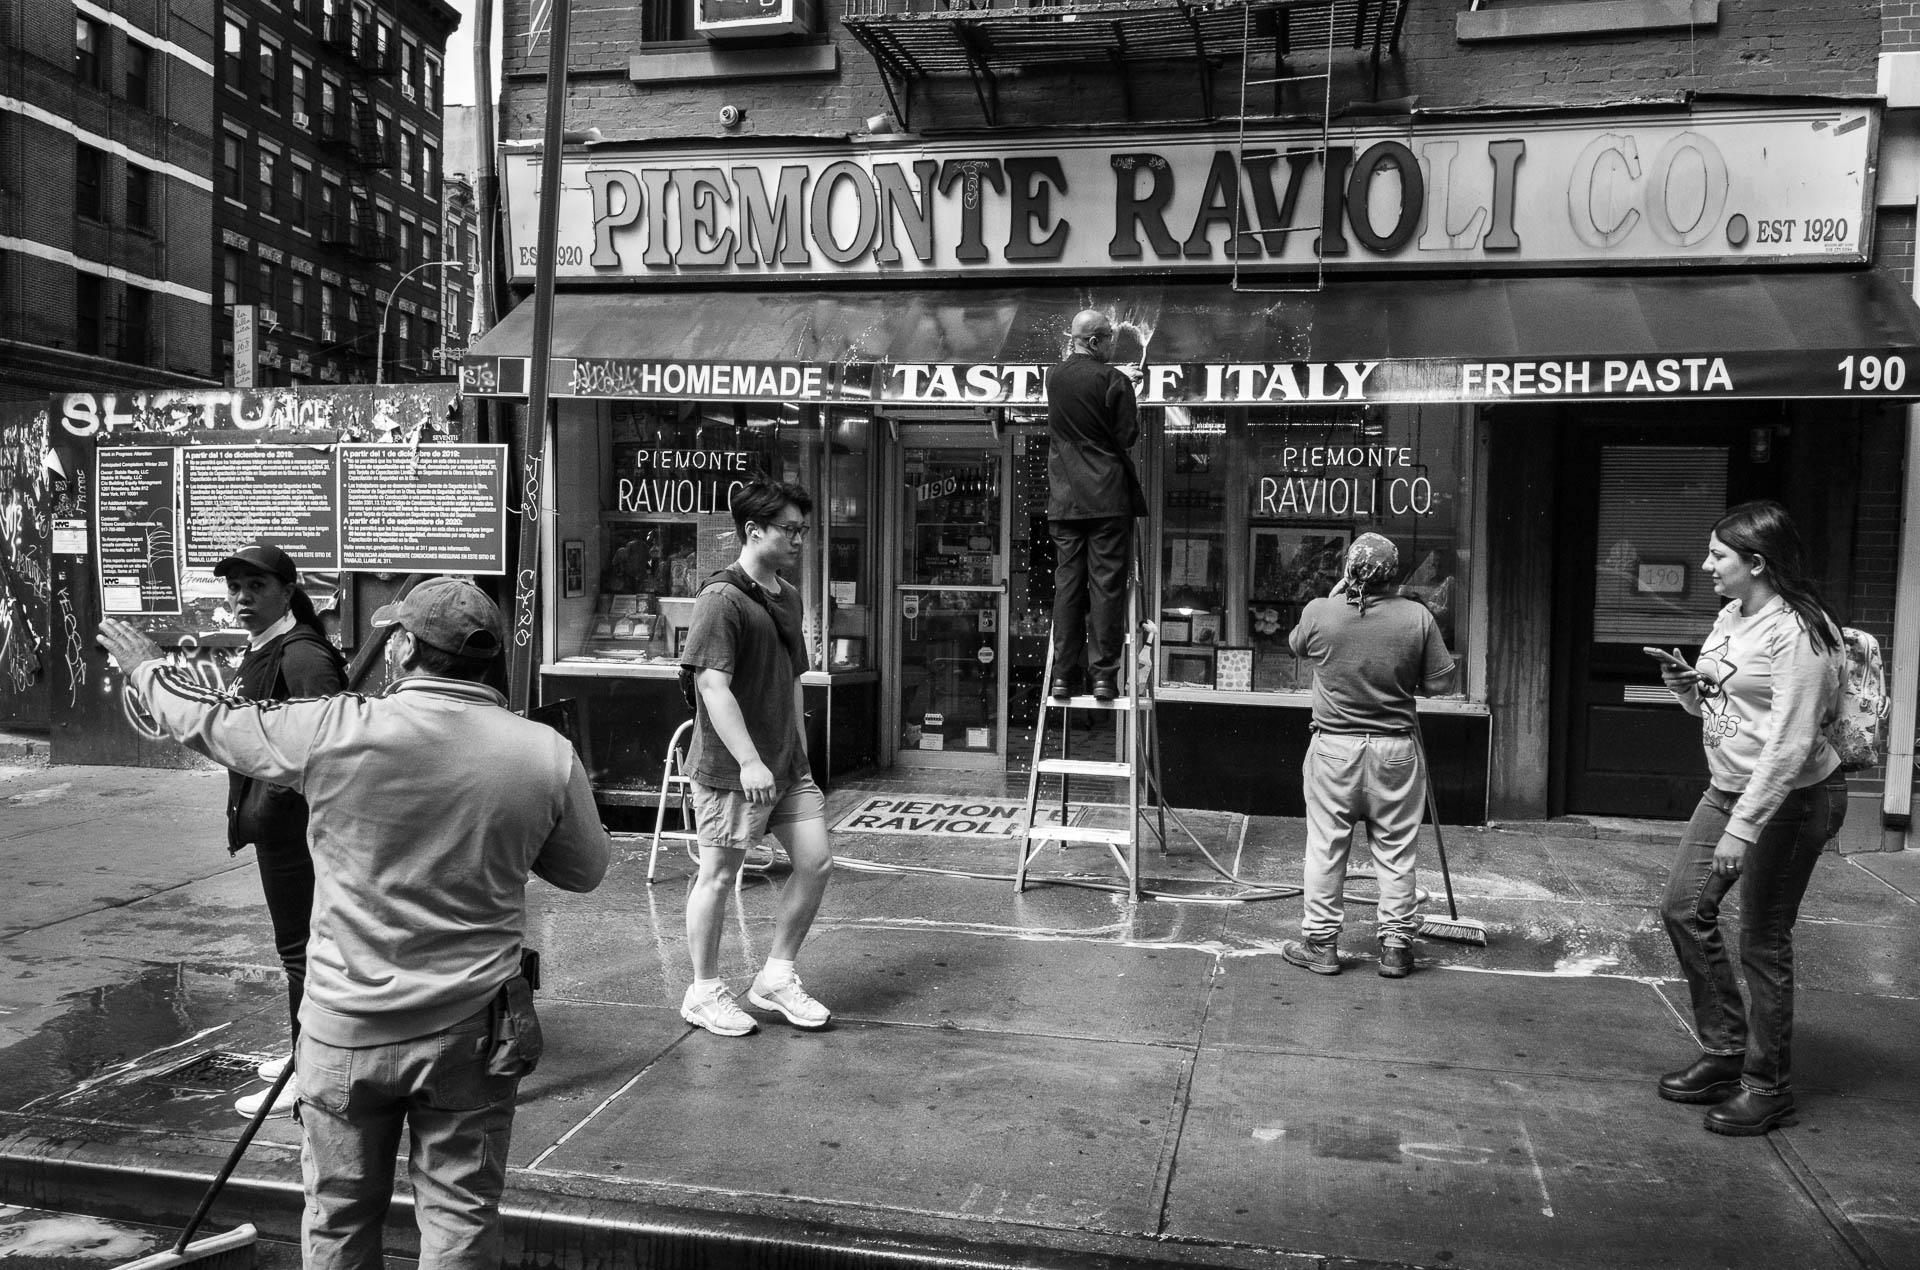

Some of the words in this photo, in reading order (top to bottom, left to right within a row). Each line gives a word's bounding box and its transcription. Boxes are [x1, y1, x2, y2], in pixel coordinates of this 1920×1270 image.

[585, 156, 1069, 267] PIEMONTE
[1108, 139, 1525, 257] RAVIOLI
[1566, 132, 1750, 249] CO.
[1756, 219, 1796, 243] EST
[1803, 218, 1848, 242] 1920
[519, 246, 538, 266] ES
[556, 246, 583, 266] 920
[641, 364, 821, 399] HOMEMADE
[892, 365, 1048, 402] TAST
[1115, 365, 1184, 402] F
[1204, 362, 1379, 401] ITALY
[1462, 360, 1591, 396] FRESH
[1603, 357, 1734, 393] PASTA
[1837, 355, 1906, 391] 190
[637, 450, 747, 471] PIEMONTE
[1283, 447, 1412, 467] PIEMONTE
[618, 478, 717, 513] RAVIOLI
[922, 478, 954, 499] 190
[1260, 477, 1376, 514] RAVIOLI
[180, 571, 225, 586] Gennaro
[1645, 568, 1680, 586] 190
